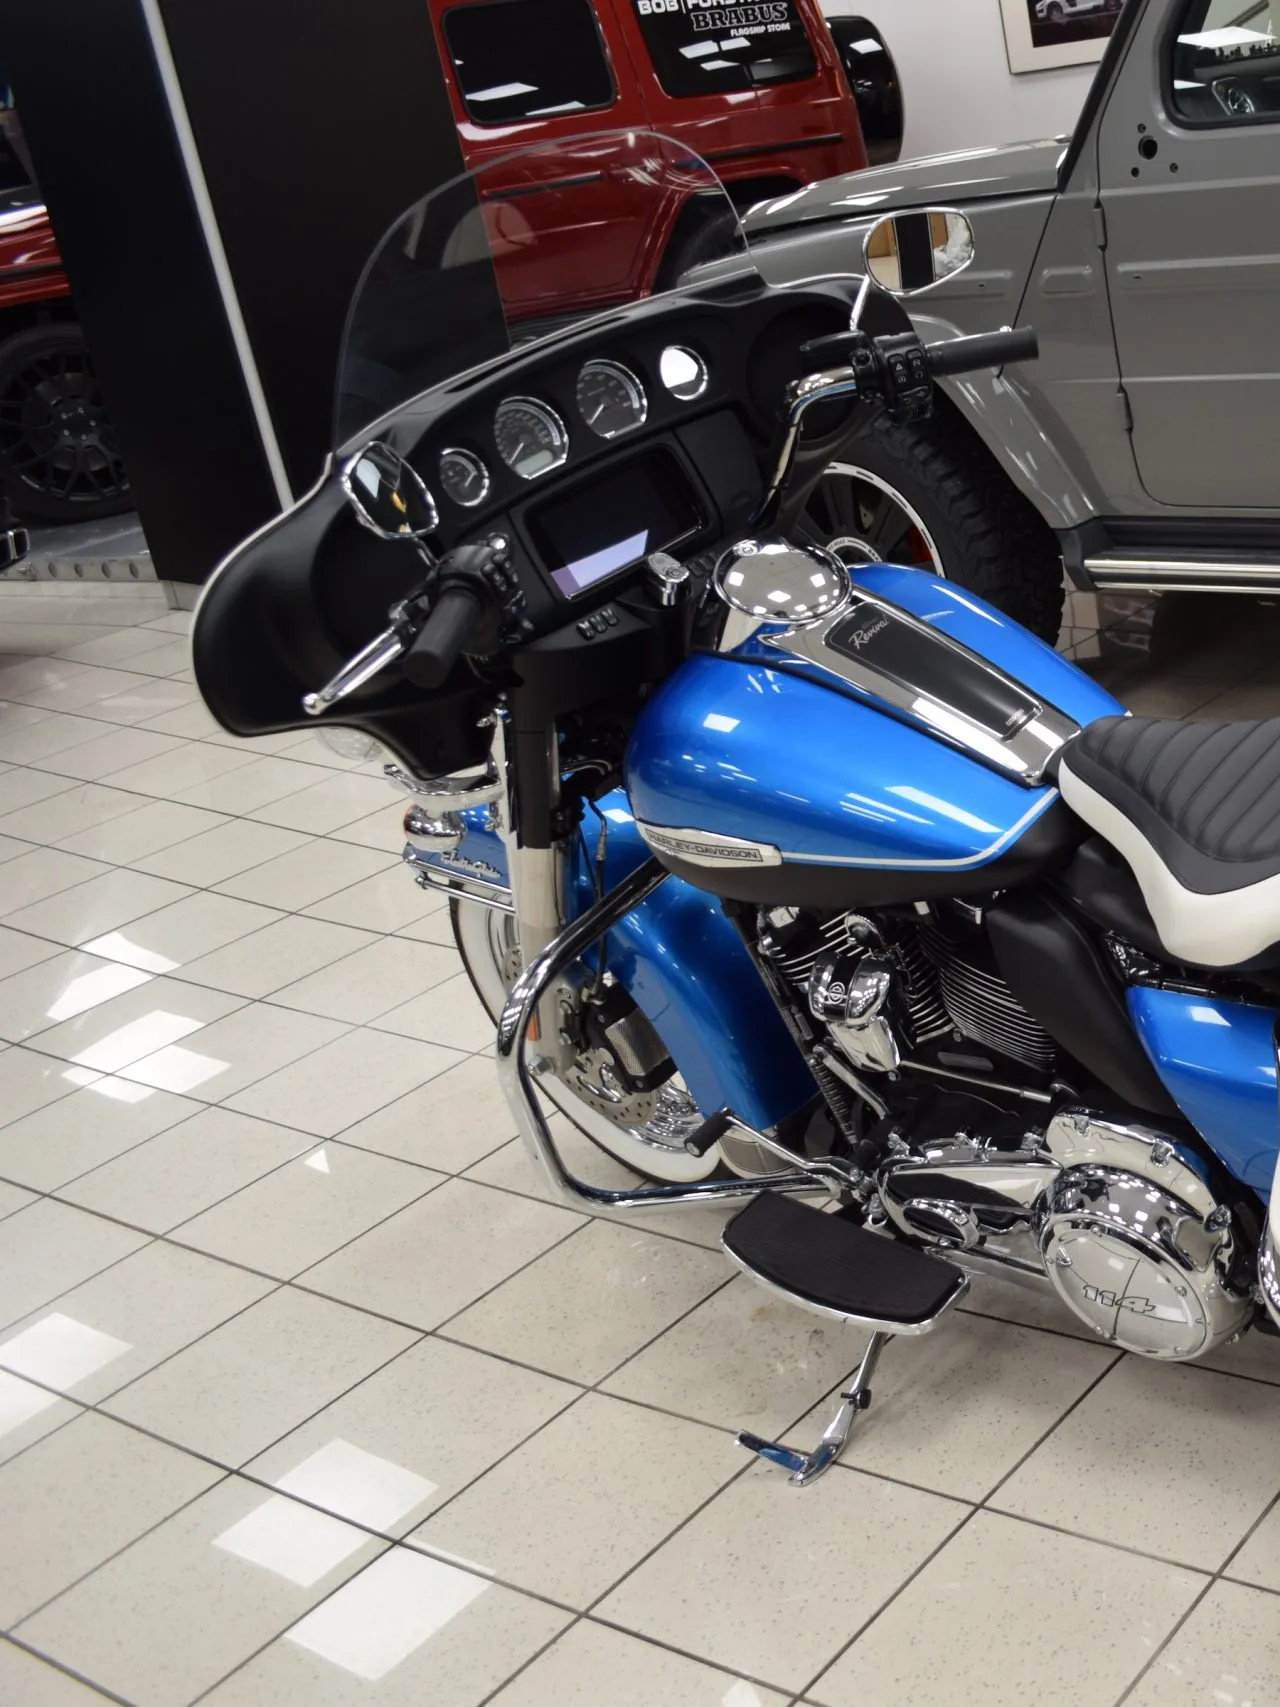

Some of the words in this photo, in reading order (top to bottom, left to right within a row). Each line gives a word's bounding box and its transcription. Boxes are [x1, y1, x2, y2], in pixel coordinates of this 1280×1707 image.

[638, 0, 680, 15] BOB
[730, 25, 766, 37] FLAGSHIP
[767, 22, 790, 33] STORE
[648, 833, 759, 859] HARLEY-DAVIDSON
[1082, 1284, 1157, 1314] 114
